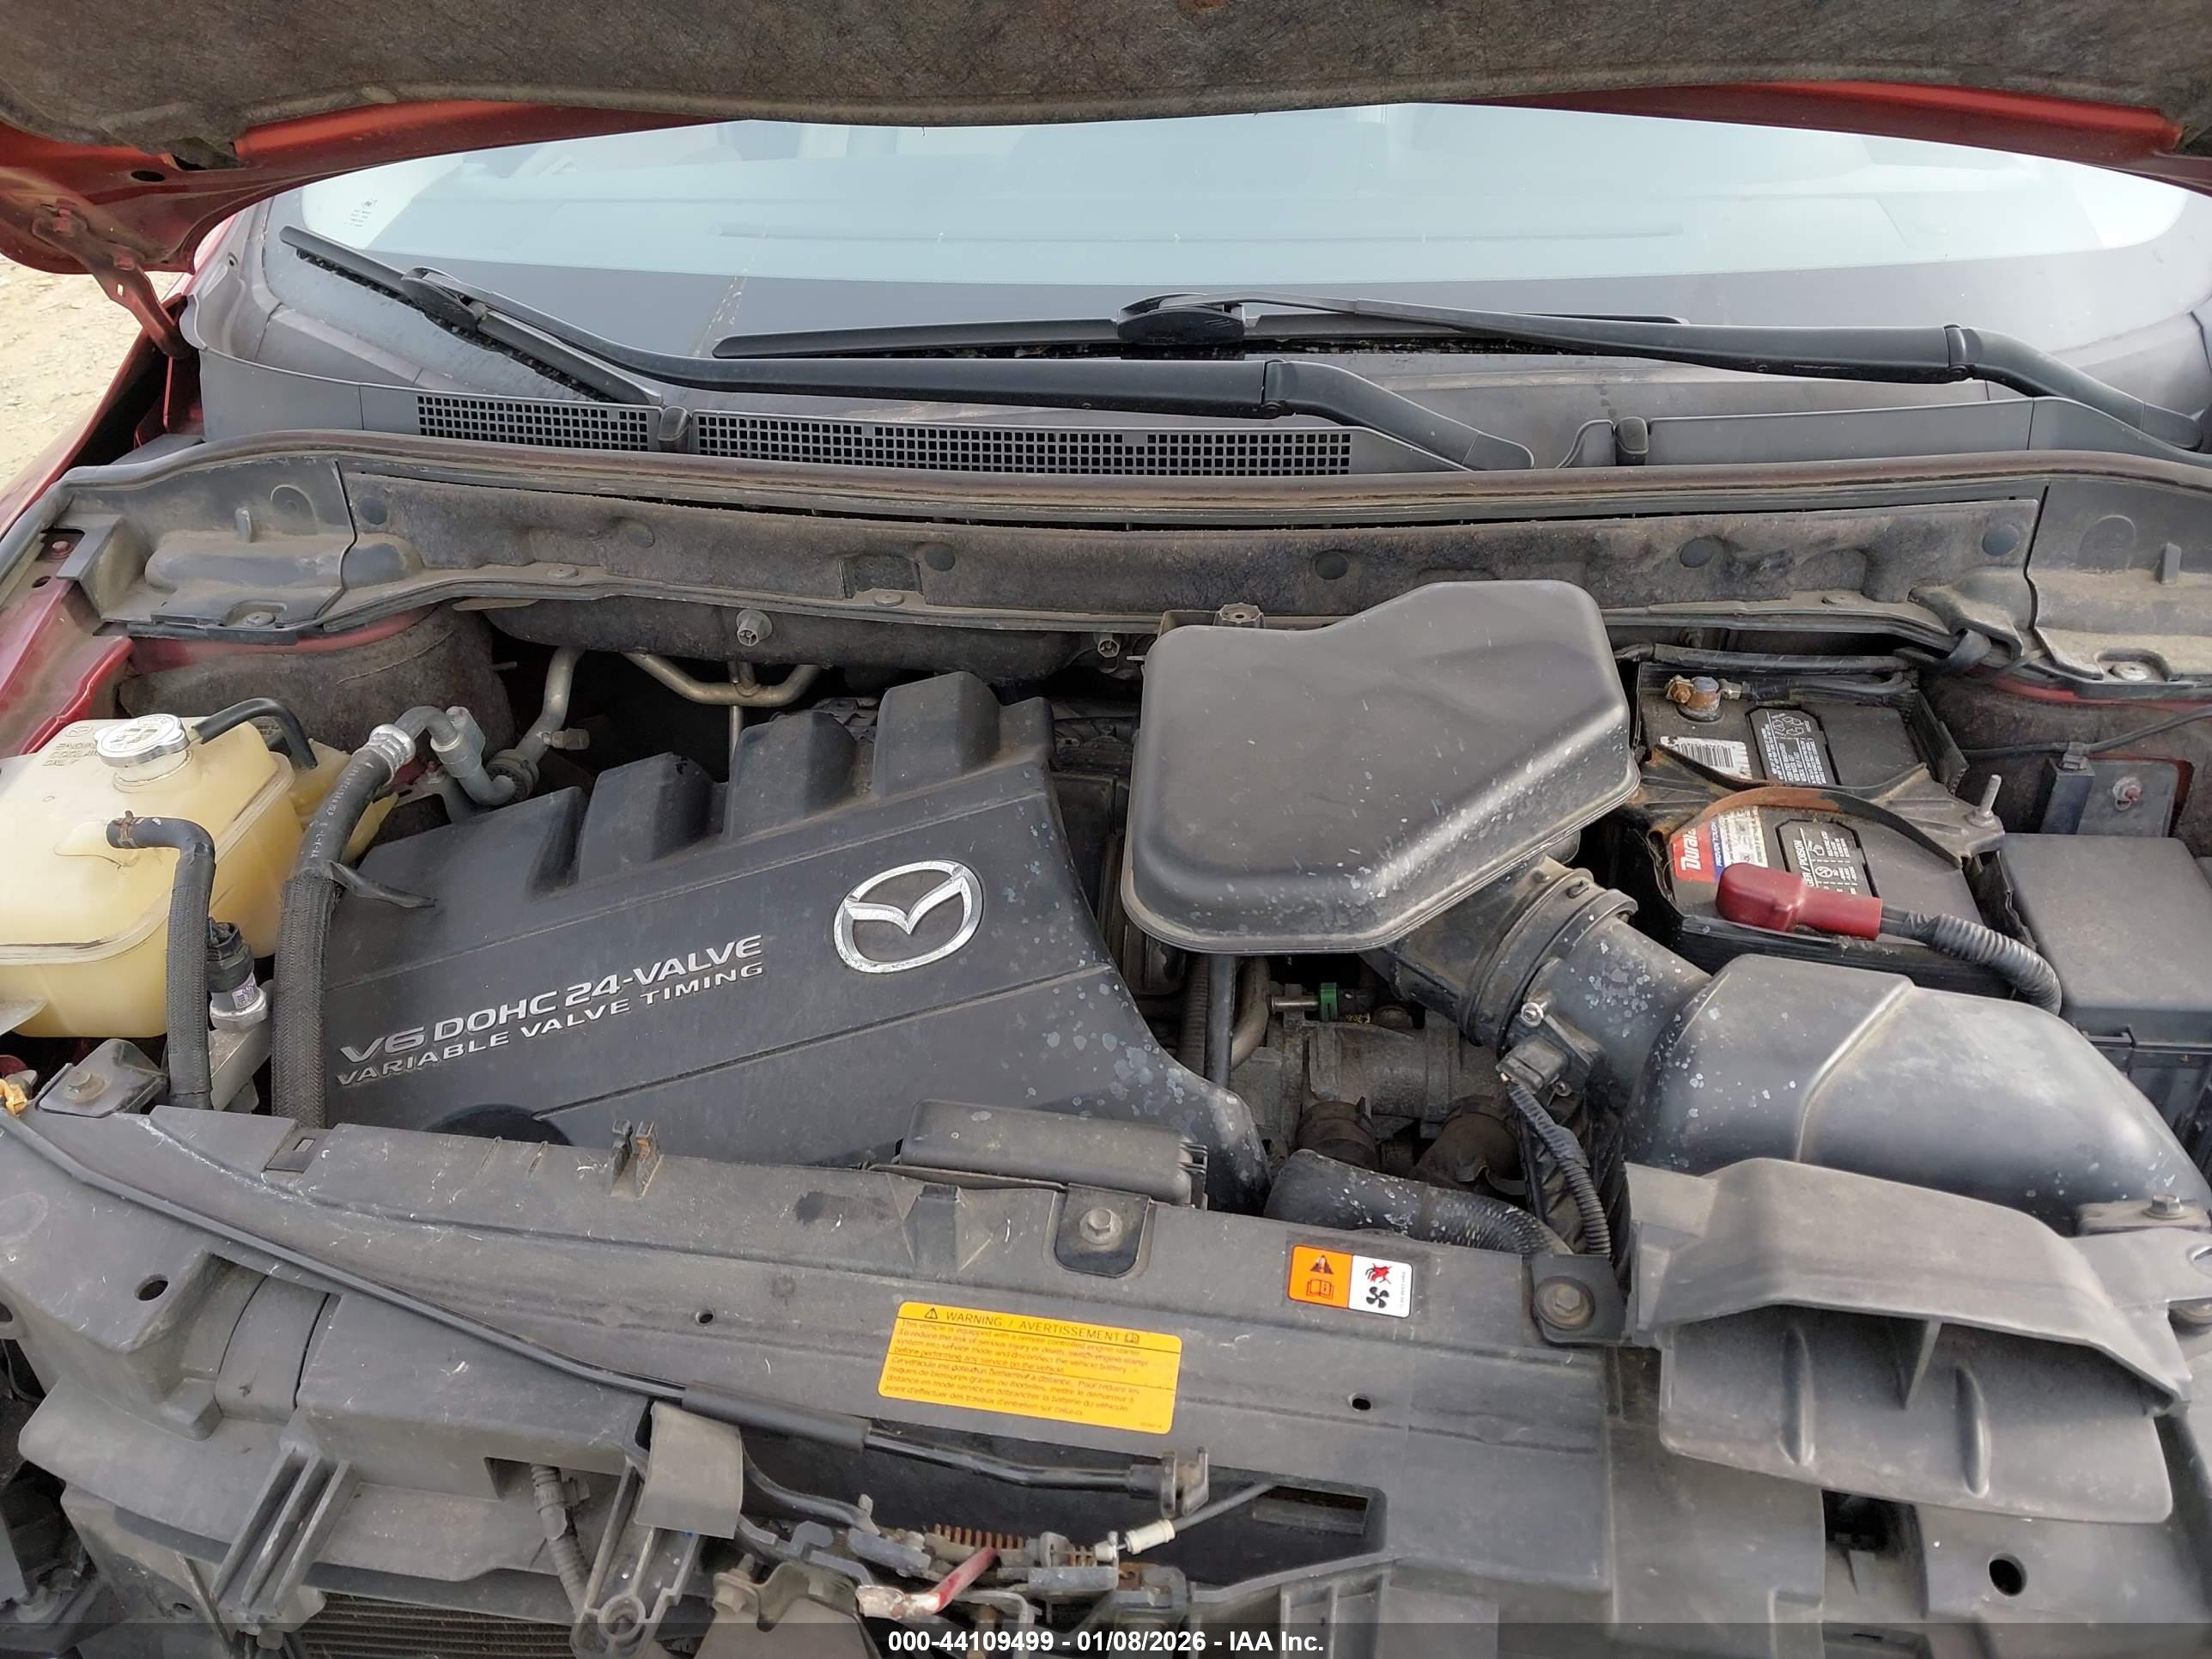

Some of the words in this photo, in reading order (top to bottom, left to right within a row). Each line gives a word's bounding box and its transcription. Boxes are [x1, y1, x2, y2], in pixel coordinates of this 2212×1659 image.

[1794, 839, 1808, 866] POISON
[1802, 872, 1814, 887] GER
[341, 1025, 425, 1063] V6
[434, 991, 559, 1042] DOHC
[564, 933, 763, 1007] 24-VALVE
[336, 1031, 509, 1085] VARIABLE
[520, 998, 630, 1039] VALVE
[640, 962, 764, 1006] TIMING
[945, 1311, 1003, 1327] WARNING
[1019, 1321, 1119, 1341] AVERTISSEMENT
